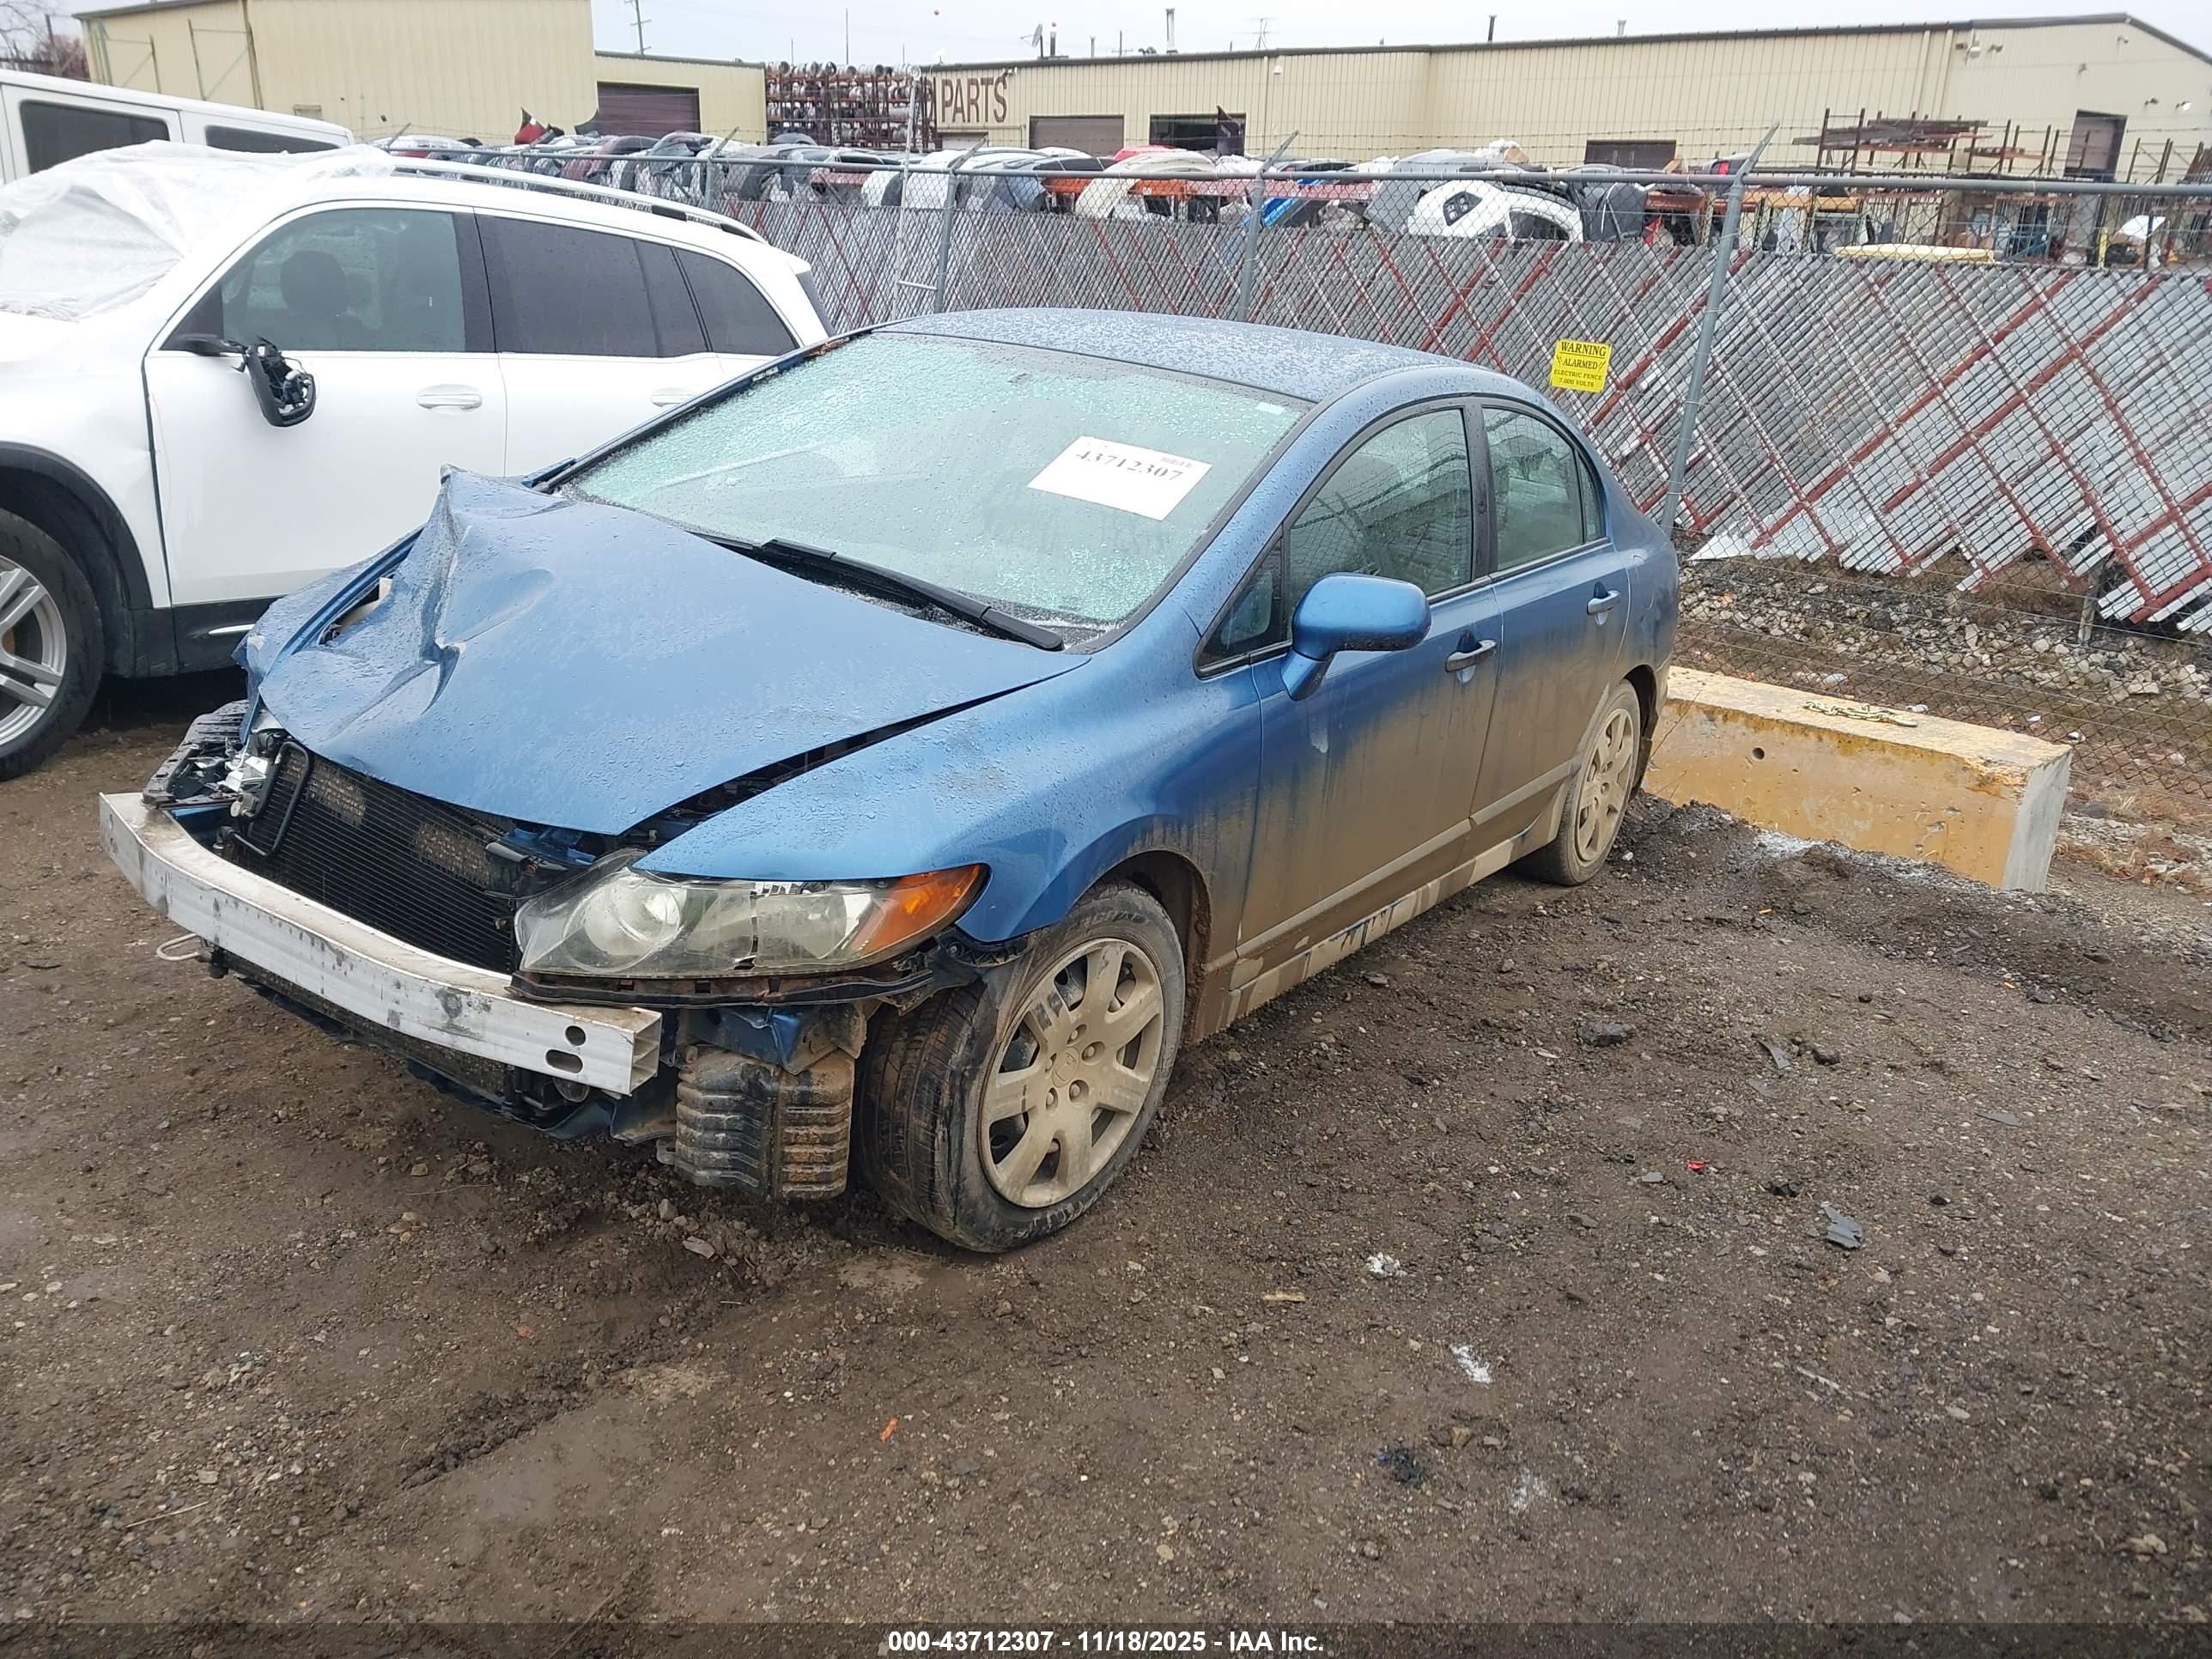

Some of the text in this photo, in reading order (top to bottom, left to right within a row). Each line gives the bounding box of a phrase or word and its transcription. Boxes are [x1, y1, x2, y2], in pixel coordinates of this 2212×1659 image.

[941, 76, 1007, 123] PARTS
[1561, 342, 1607, 356] WARNING
[1563, 358, 1598, 370] ALARMED
[1553, 369, 1583, 378] ELECTRIC
[1077, 451, 1183, 480] 43712307
